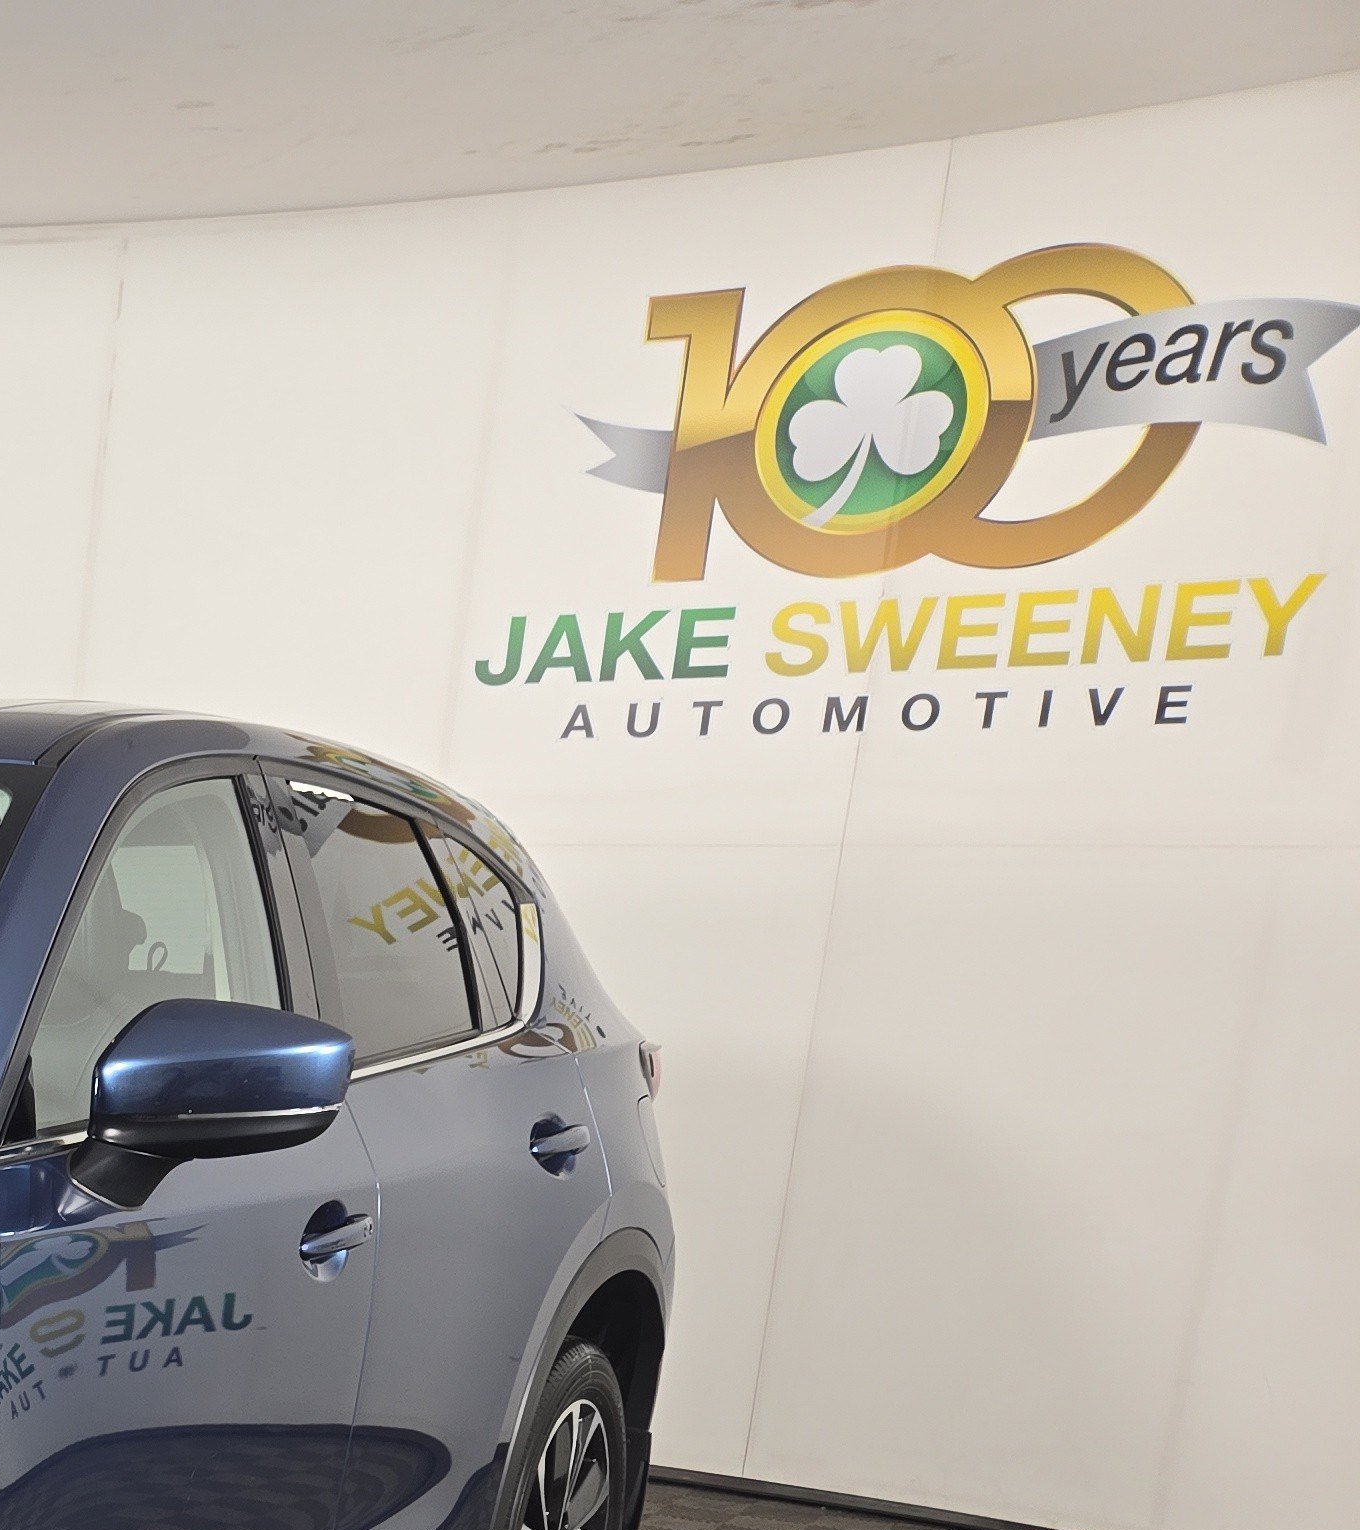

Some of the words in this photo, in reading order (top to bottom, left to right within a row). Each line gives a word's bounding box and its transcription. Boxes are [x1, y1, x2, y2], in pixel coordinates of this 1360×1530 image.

[1049, 318, 1295, 422] years
[475, 606, 736, 686] JAKE
[764, 573, 1327, 676] SWEENEY
[560, 684, 1194, 740] AUTOMOTIVE
